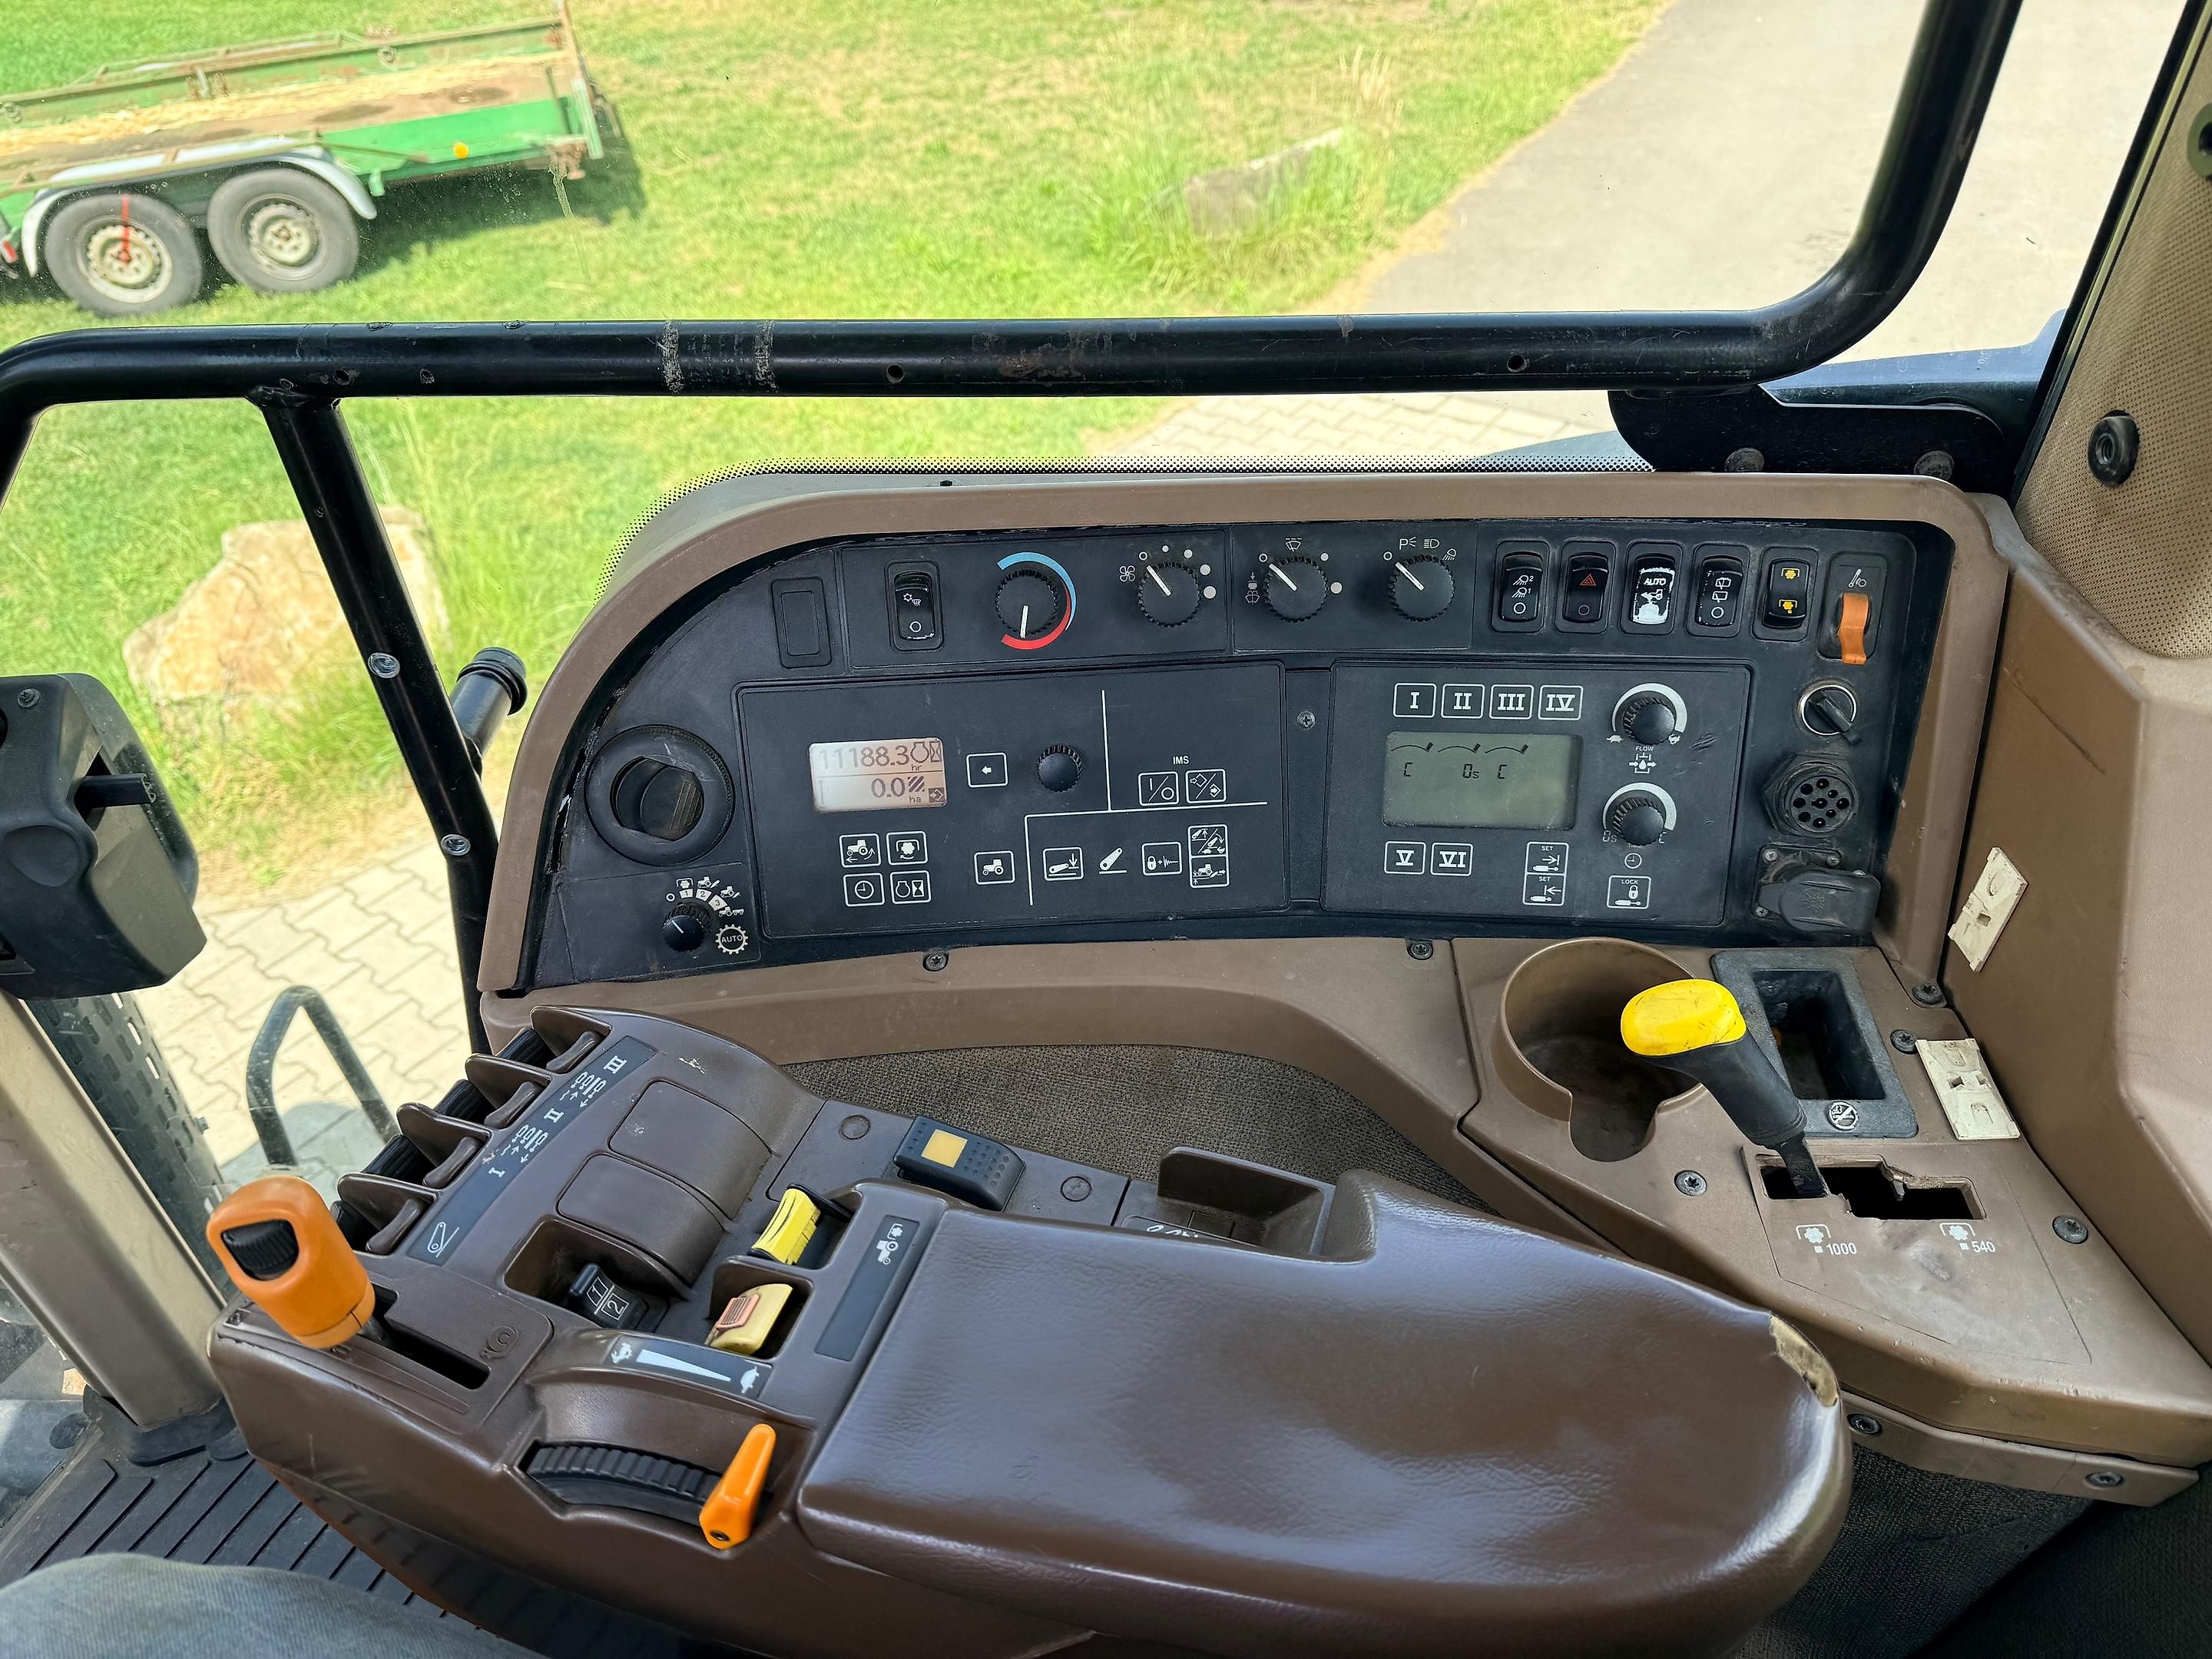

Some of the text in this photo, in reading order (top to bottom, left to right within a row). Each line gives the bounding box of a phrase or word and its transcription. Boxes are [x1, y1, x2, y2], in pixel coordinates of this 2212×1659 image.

[1644, 578, 1666, 586] AUTO
[1410, 691, 1419, 709] I
[1453, 692, 1472, 710] II
[1497, 693, 1525, 711] III
[1545, 694, 1575, 712] IV
[819, 745, 910, 770] 11188.3
[1173, 755, 1190, 765] IMS
[871, 777, 906, 798] 0.0
[909, 796, 922, 804] ha
[1396, 849, 1415, 866] V
[1439, 850, 1467, 868] VI
[722, 935, 743, 943] AUTO
[603, 1055, 628, 1075] III
[543, 1108, 565, 1123] II
[1826, 1242, 1857, 1255] 1000
[1971, 1240, 1996, 1253] 540
[591, 1284, 604, 1298] 1
[607, 1300, 624, 1315] 2
